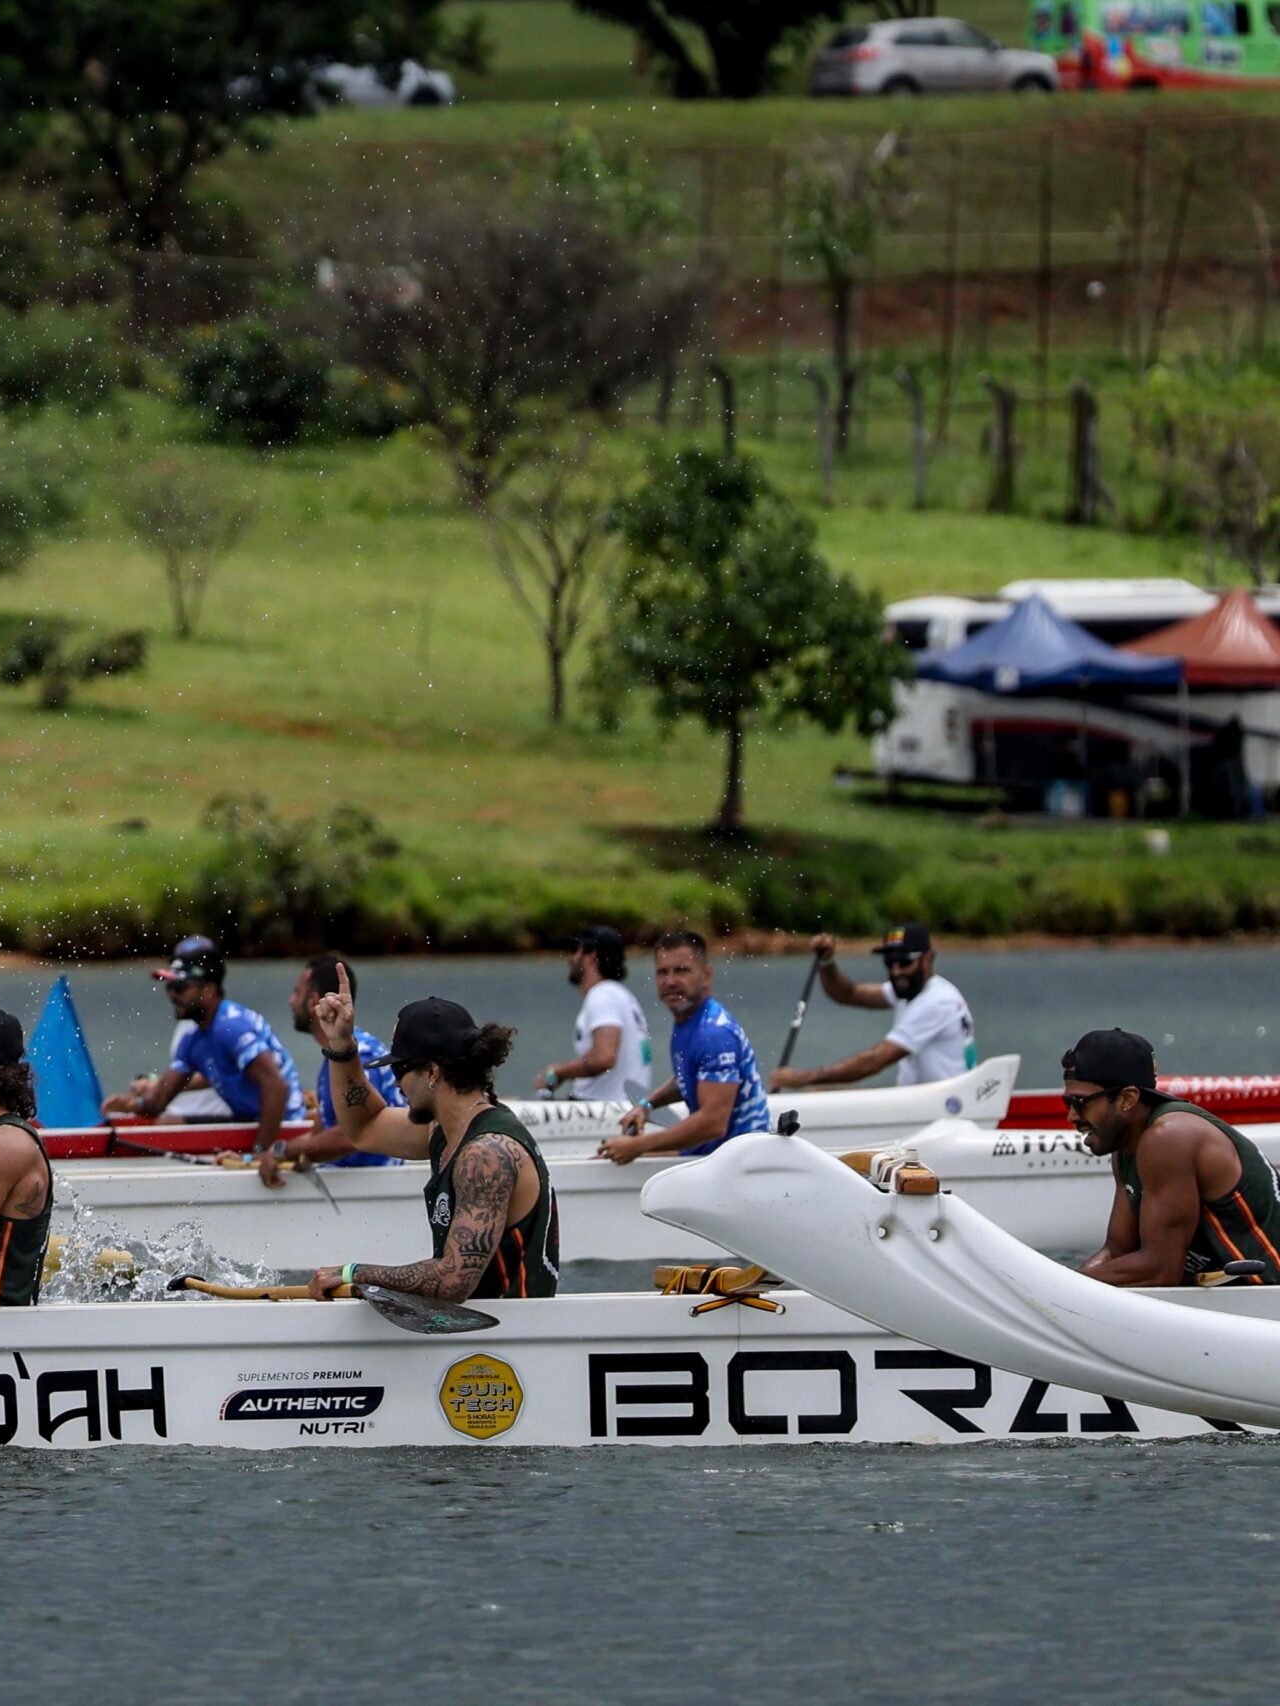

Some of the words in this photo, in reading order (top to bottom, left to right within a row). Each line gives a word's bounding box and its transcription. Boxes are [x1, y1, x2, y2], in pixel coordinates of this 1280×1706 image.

[237, 1371, 309, 1382] SUPLEMENTOS
[313, 1370, 362, 1380] PREMIUM
[457, 1382, 506, 1397] SUN
[238, 1396, 367, 1412] AUTHENTIC
[449, 1398, 514, 1412] TECH
